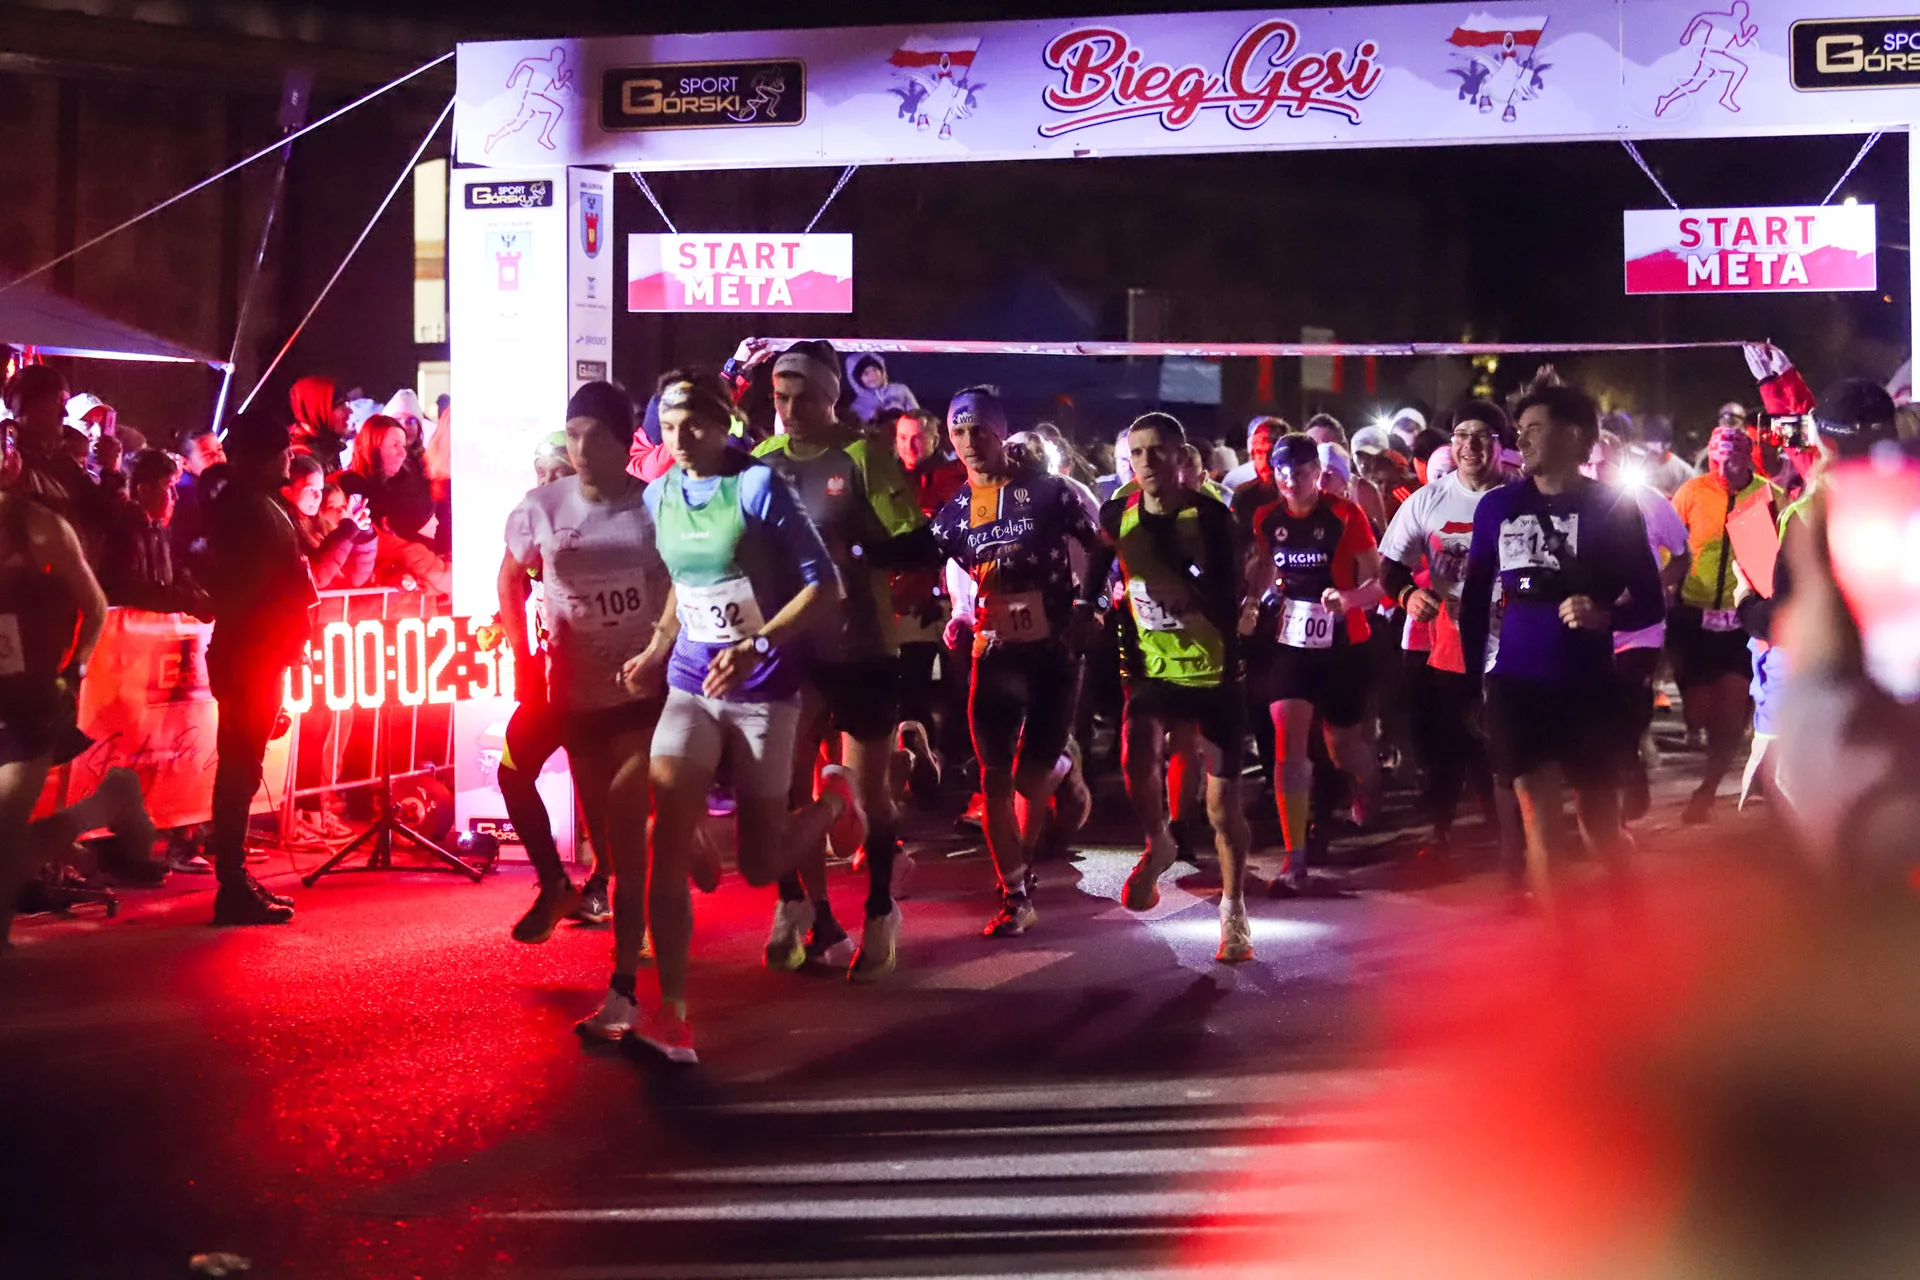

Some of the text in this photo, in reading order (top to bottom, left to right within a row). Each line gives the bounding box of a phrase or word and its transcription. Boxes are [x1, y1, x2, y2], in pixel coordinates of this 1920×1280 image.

[679, 76, 739, 94] SPORT
[1046, 18, 1384, 130] Bieg Gęsi
[621, 78, 740, 115] GÓRSKI
[498, 186, 525, 195] SPORT
[1679, 215, 1816, 248] START
[679, 241, 800, 269] START
[1687, 252, 1809, 286] META
[684, 275, 793, 306] META
[1288, 553, 1328, 564] KGHM
[595, 587, 641, 617] 108
[710, 602, 744, 629] 32
